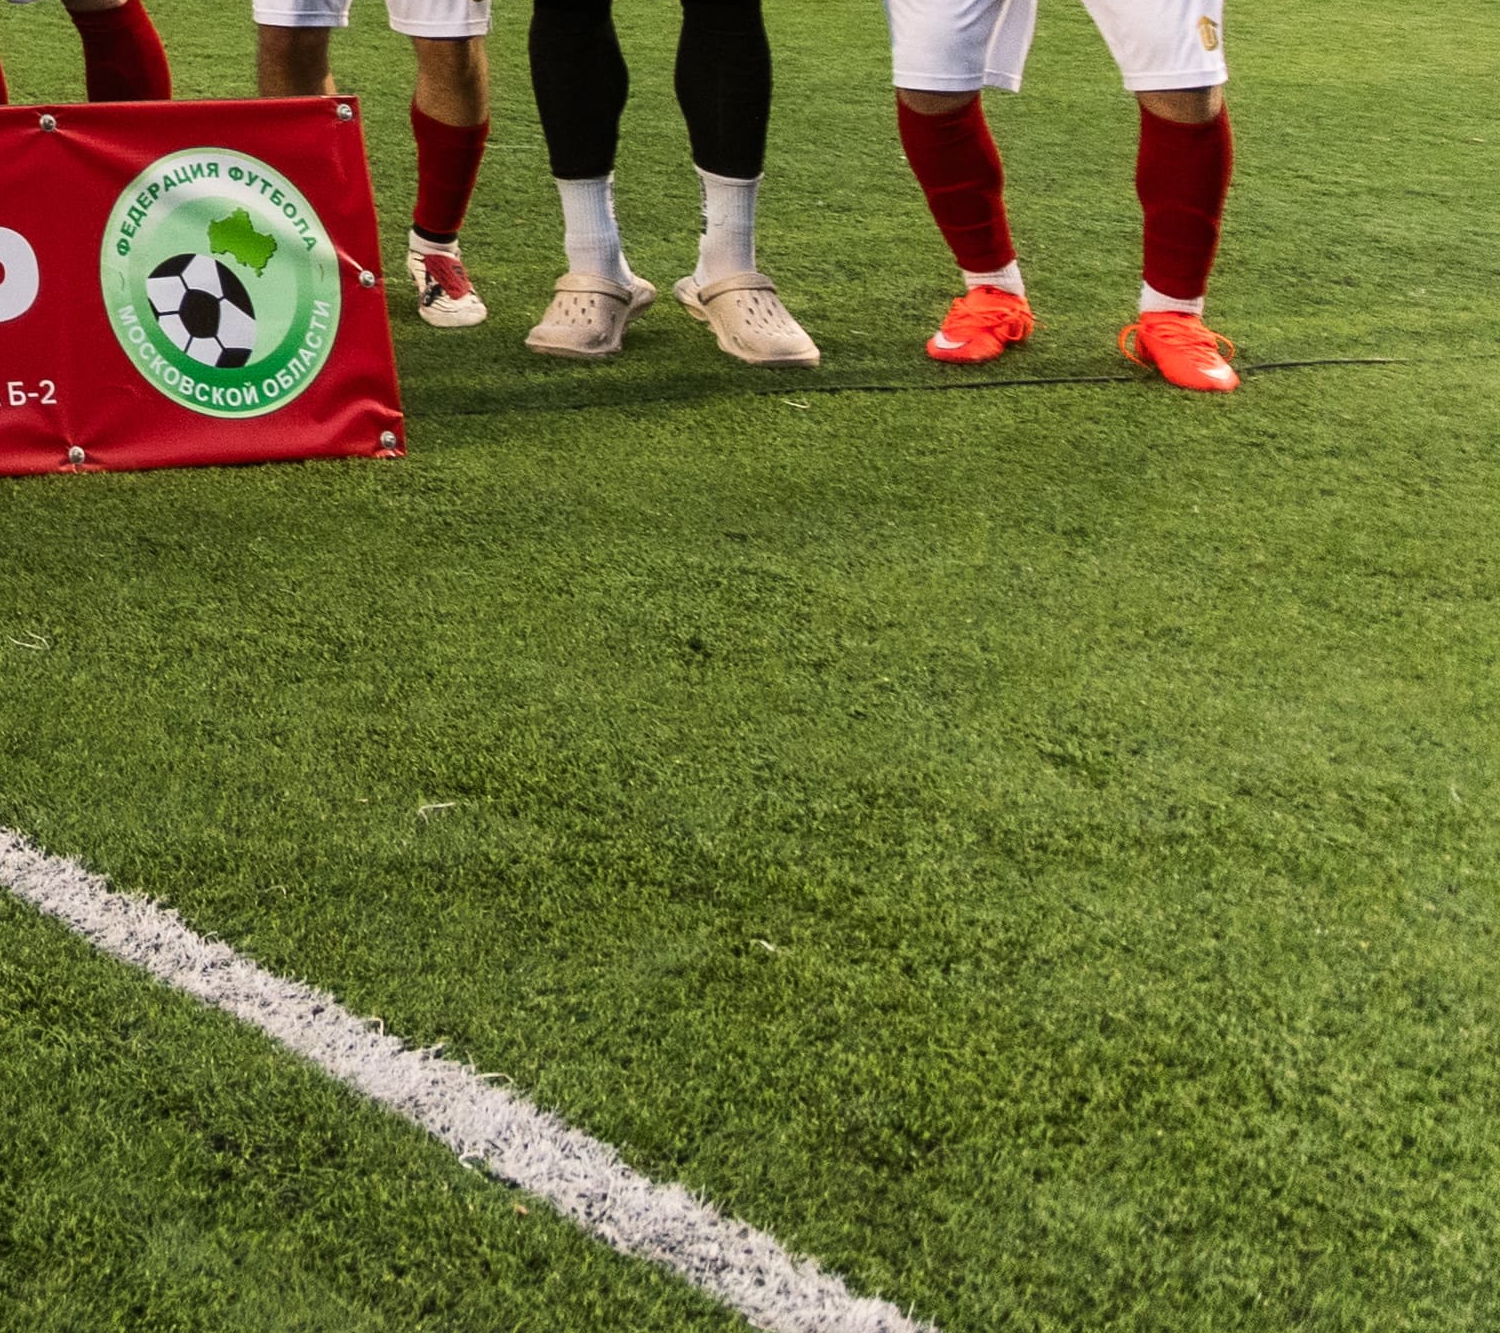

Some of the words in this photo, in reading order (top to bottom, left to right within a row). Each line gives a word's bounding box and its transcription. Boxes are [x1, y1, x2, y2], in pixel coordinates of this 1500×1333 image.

[116, 161, 220, 257] ФЕДЕРАЦИЯ
[227, 165, 318, 252] ФУТБОЛА
[7, 379, 57, 406] Б-2
[118, 304, 260, 407] МОСКОВСКОЙ
[262, 299, 332, 398] ОБЛАСТИ
